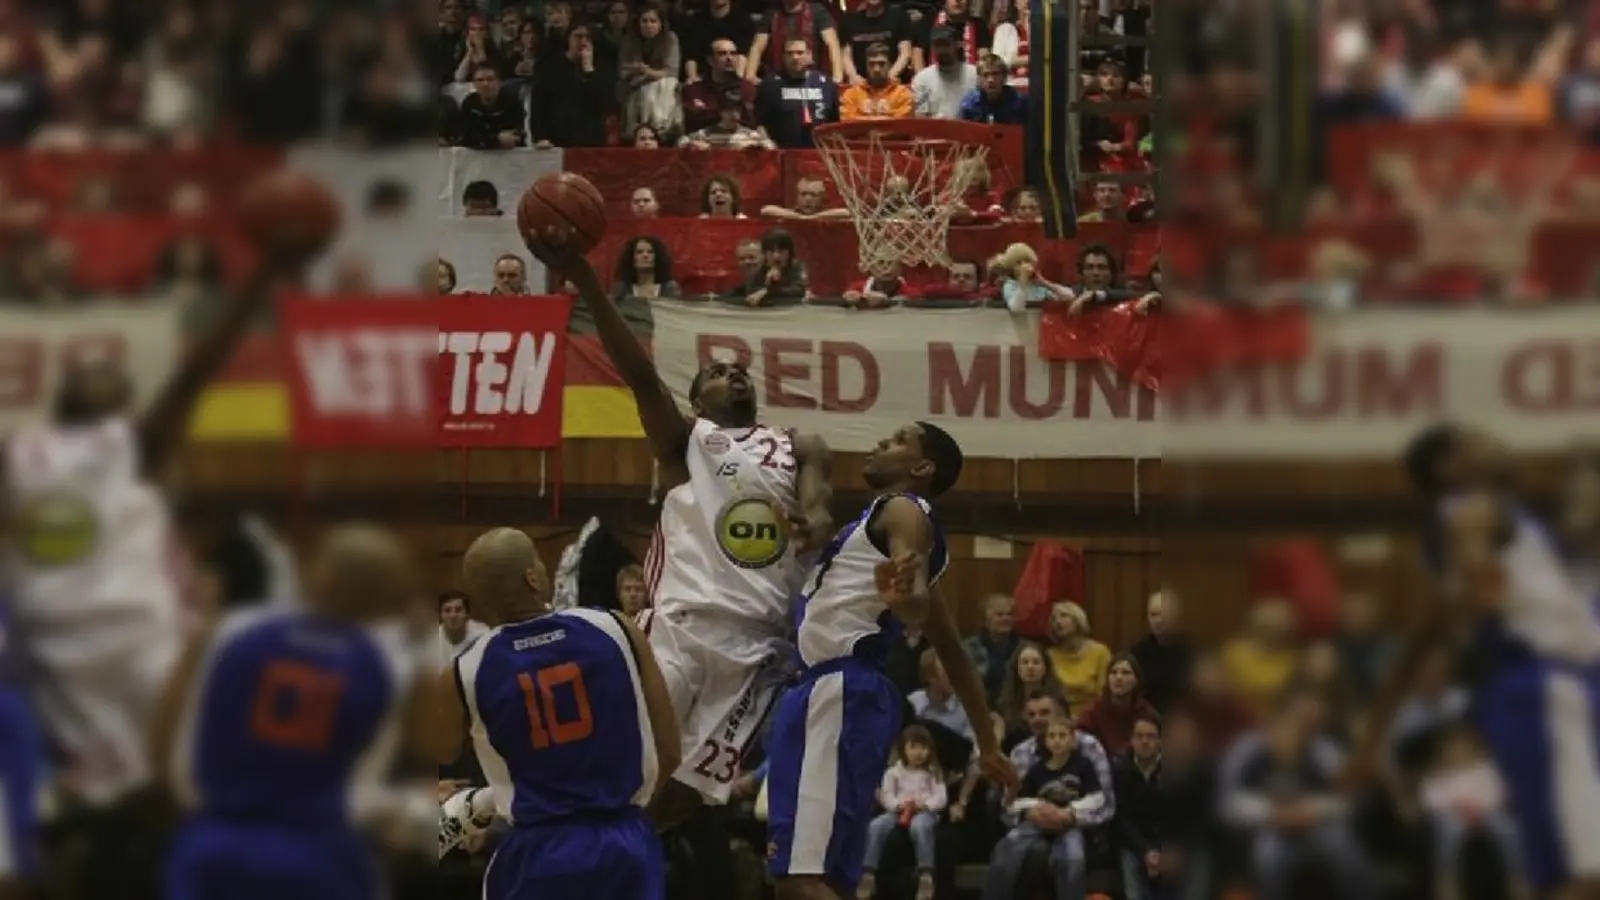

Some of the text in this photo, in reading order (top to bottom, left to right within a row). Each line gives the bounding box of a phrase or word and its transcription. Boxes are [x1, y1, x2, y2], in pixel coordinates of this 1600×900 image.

[439, 331, 556, 415] TEN
[729, 520, 776, 541] on
[517, 662, 594, 751] 10
[695, 739, 738, 784] 23
